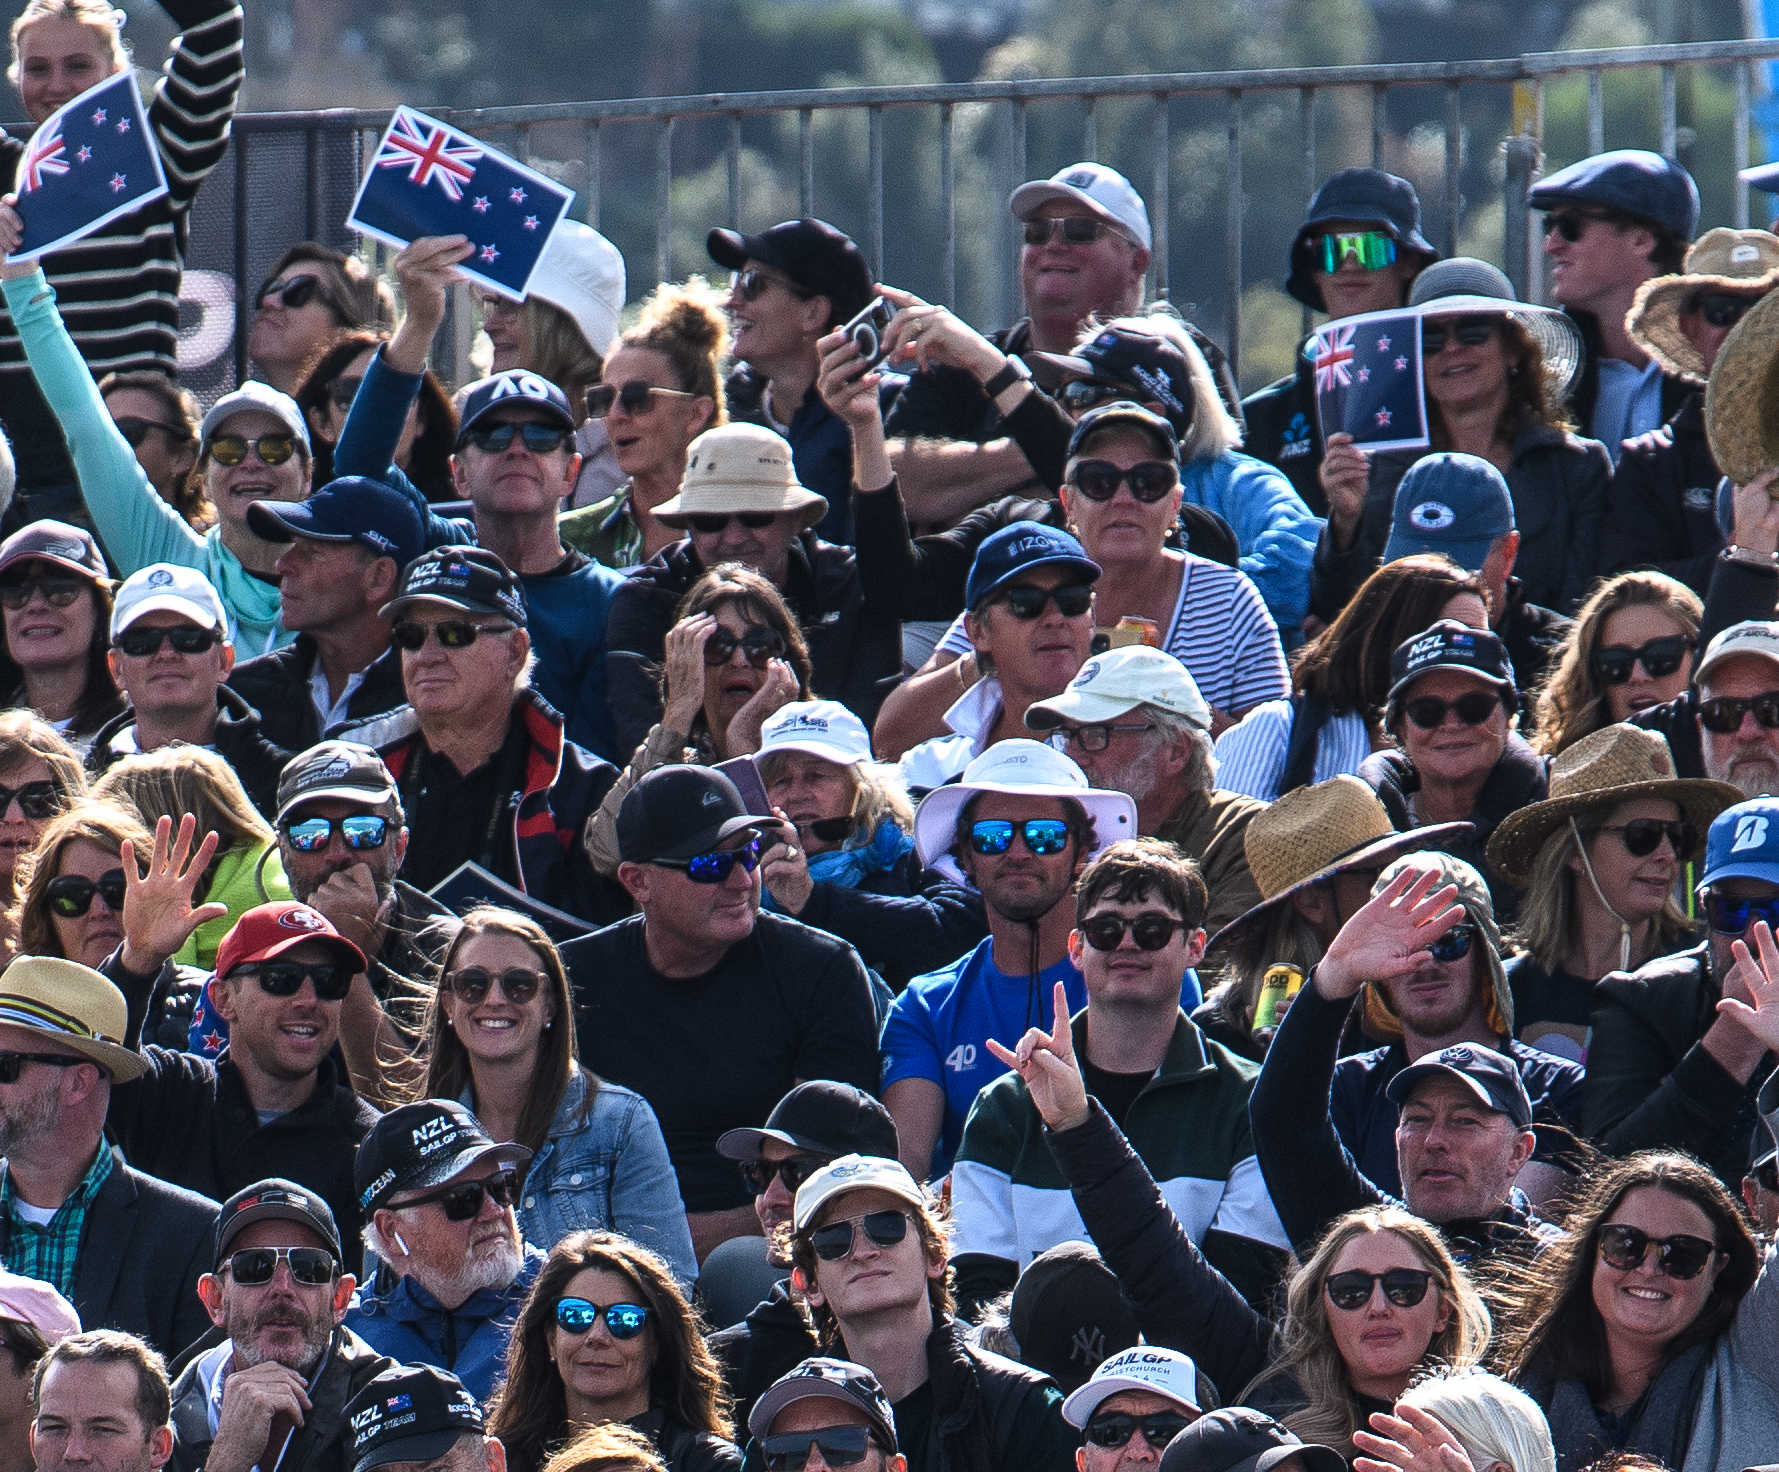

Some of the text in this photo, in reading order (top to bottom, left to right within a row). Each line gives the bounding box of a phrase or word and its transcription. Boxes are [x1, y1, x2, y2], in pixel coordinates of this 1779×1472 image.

[411, 562, 443, 580] NZL
[1408, 633, 1446, 658] NZL
[946, 1045, 977, 1072] 40
[411, 1115, 455, 1146] NZL
[351, 1404, 383, 1433] NZL
